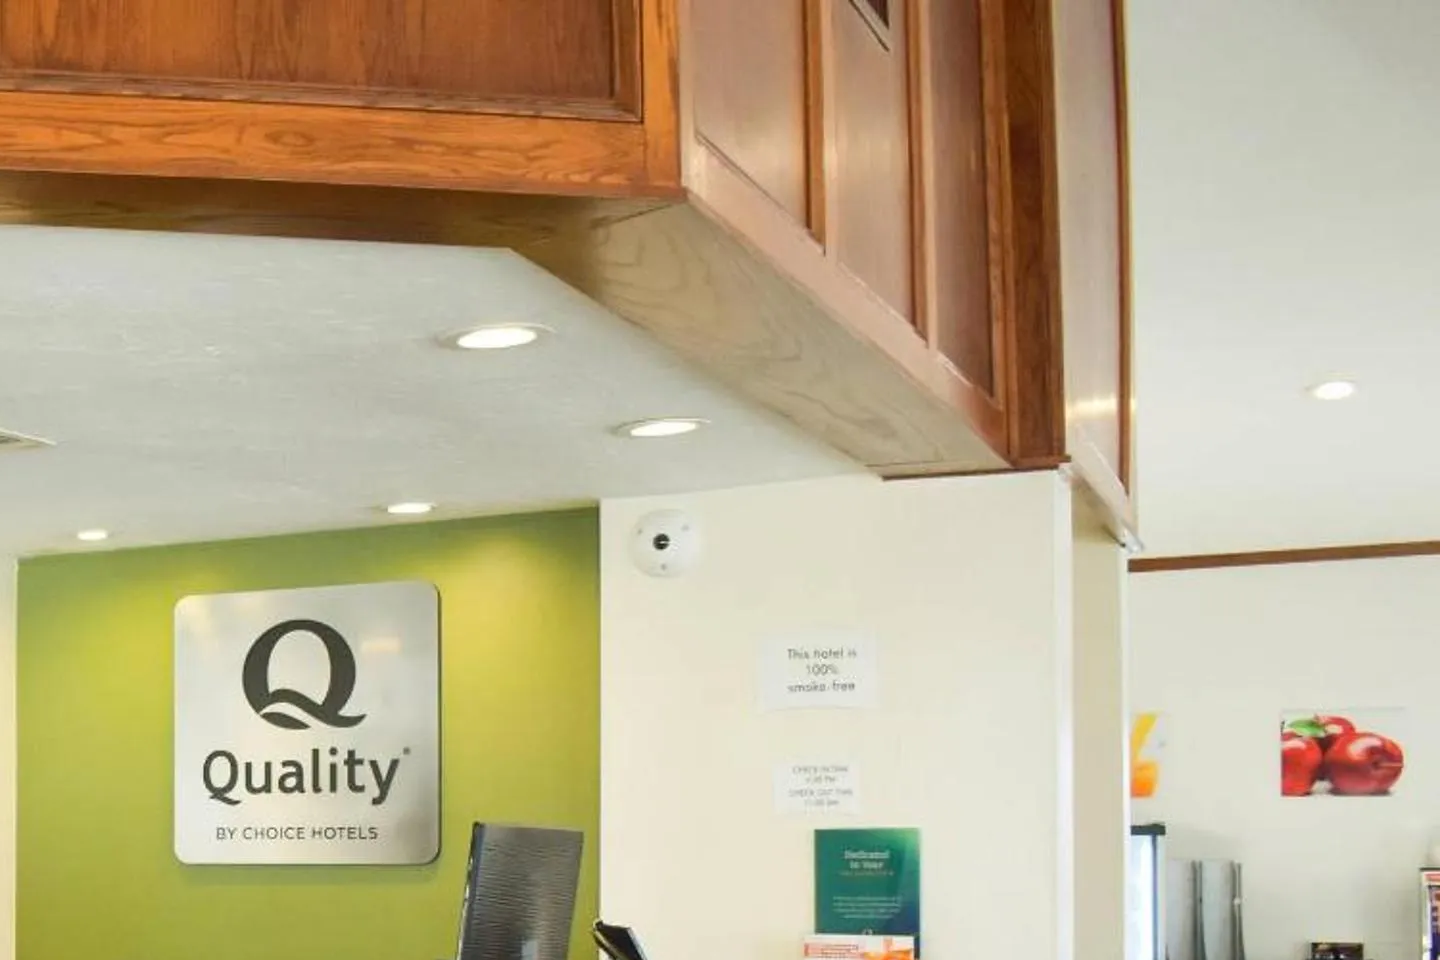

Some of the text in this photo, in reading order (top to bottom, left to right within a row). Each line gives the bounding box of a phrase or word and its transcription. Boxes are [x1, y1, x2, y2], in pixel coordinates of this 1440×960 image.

[787, 648, 810, 660] This
[813, 647, 844, 660] hotel
[242, 618, 367, 730] Q
[203, 747, 401, 806] Quality
[216, 826, 379, 840] BY CHOICE HOTELS
